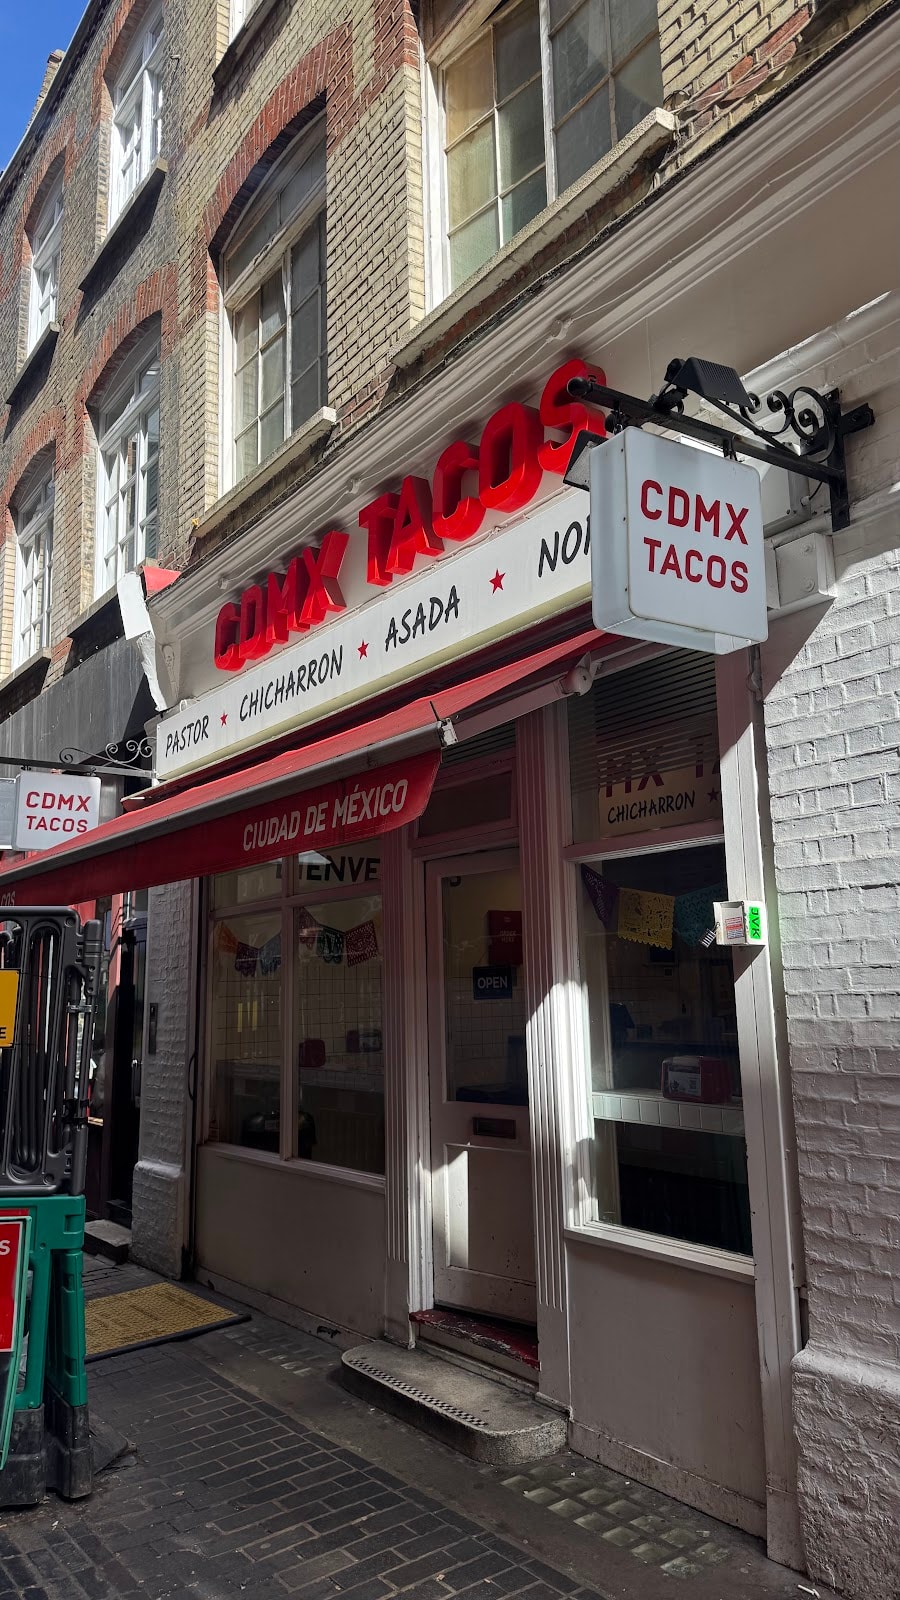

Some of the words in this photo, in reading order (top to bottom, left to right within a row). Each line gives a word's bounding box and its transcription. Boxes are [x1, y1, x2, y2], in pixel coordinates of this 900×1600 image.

[214, 530, 350, 671] CDMX
[359, 359, 606, 587] TACOS
[640, 479, 749, 545] CDMX
[643, 536, 749, 594] TACOS
[165, 715, 209, 758] PASTOR
[239, 644, 343, 722] CHICHARRON
[385, 585, 461, 652] ASADA
[26, 791, 91, 812] CDMX
[243, 810, 301, 851] CIUDAD
[303, 801, 329, 836] DE
[331, 779, 409, 828] MÉXICO
[607, 789, 695, 824] CHICHARRON
[26, 815, 88, 833] TACOS
[276, 855, 381, 883] ENVE
[750, 907, 761, 939] JVK
[477, 976, 508, 989] OPEN
